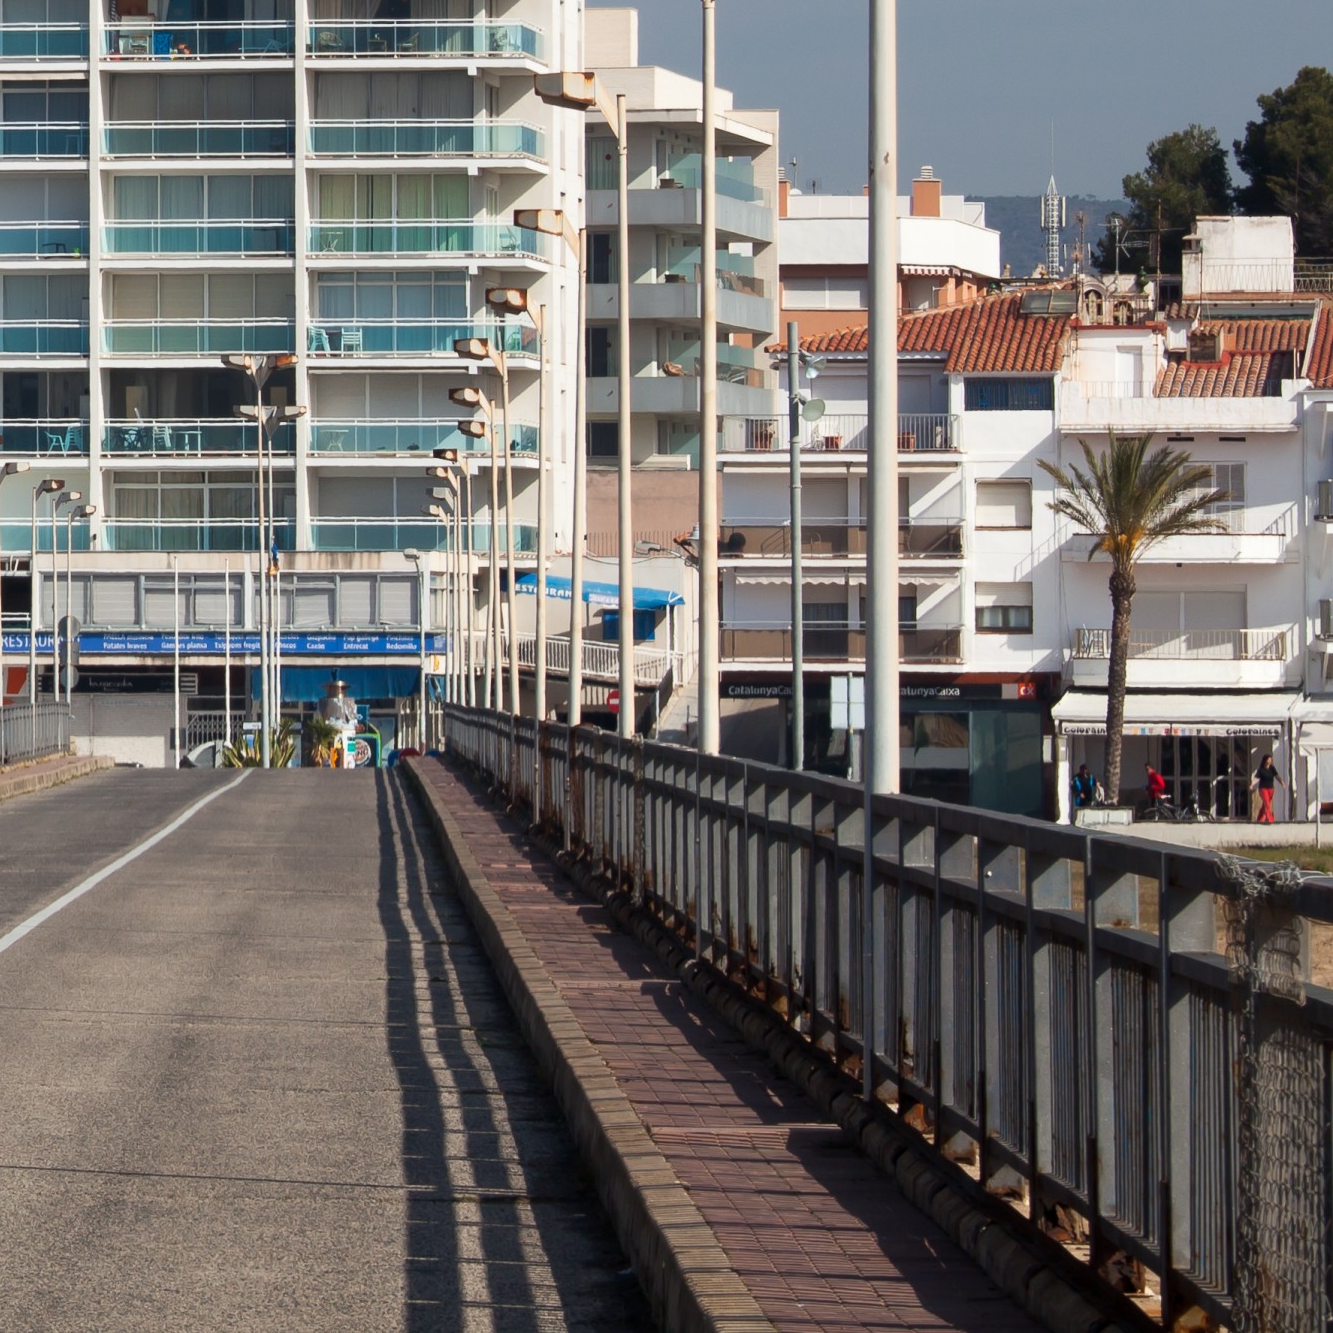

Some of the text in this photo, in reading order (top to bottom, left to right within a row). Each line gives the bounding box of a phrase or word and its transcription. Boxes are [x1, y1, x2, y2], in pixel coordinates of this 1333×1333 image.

[1, 635, 82, 648] RESTAURT
[728, 685, 793, 697] CatalunyaCai
[900, 685, 961, 697] alunyaCaixa
